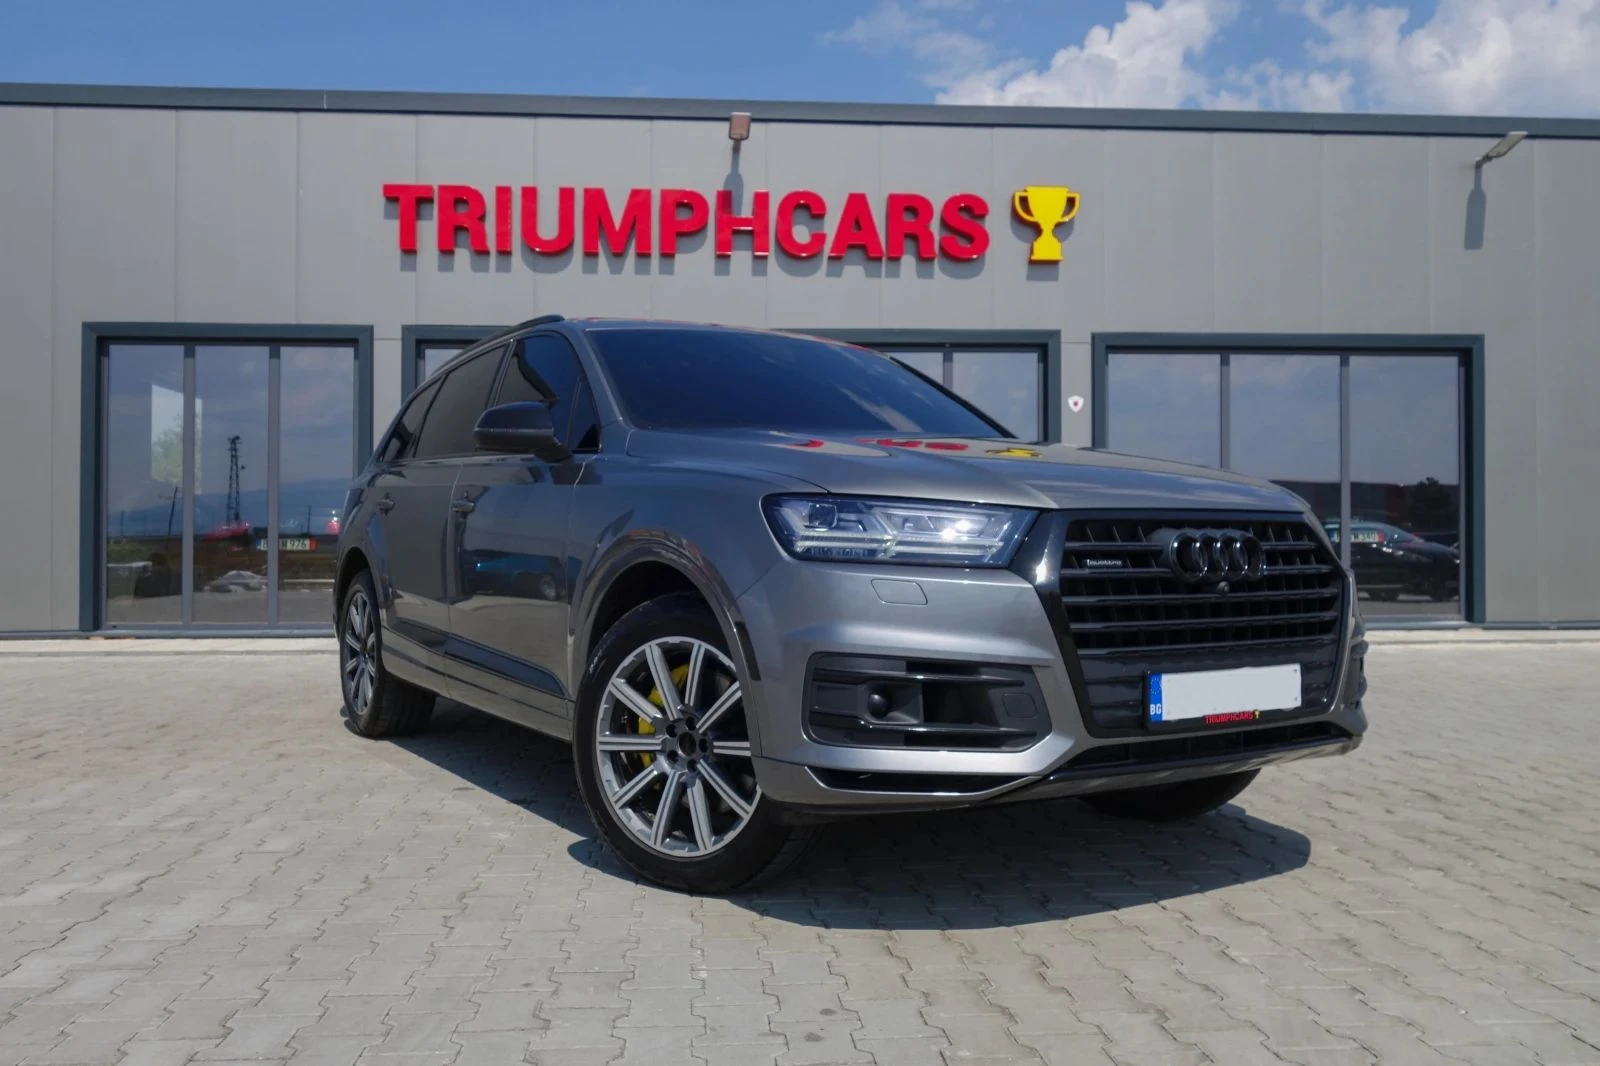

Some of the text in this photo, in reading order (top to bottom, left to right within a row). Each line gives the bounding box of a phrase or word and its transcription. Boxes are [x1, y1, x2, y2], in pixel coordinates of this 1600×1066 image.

[382, 184, 991, 261] TRIUMPHCARS
[1150, 703, 1162, 715] BG
[1205, 711, 1254, 724] TRIUMPHCARS
